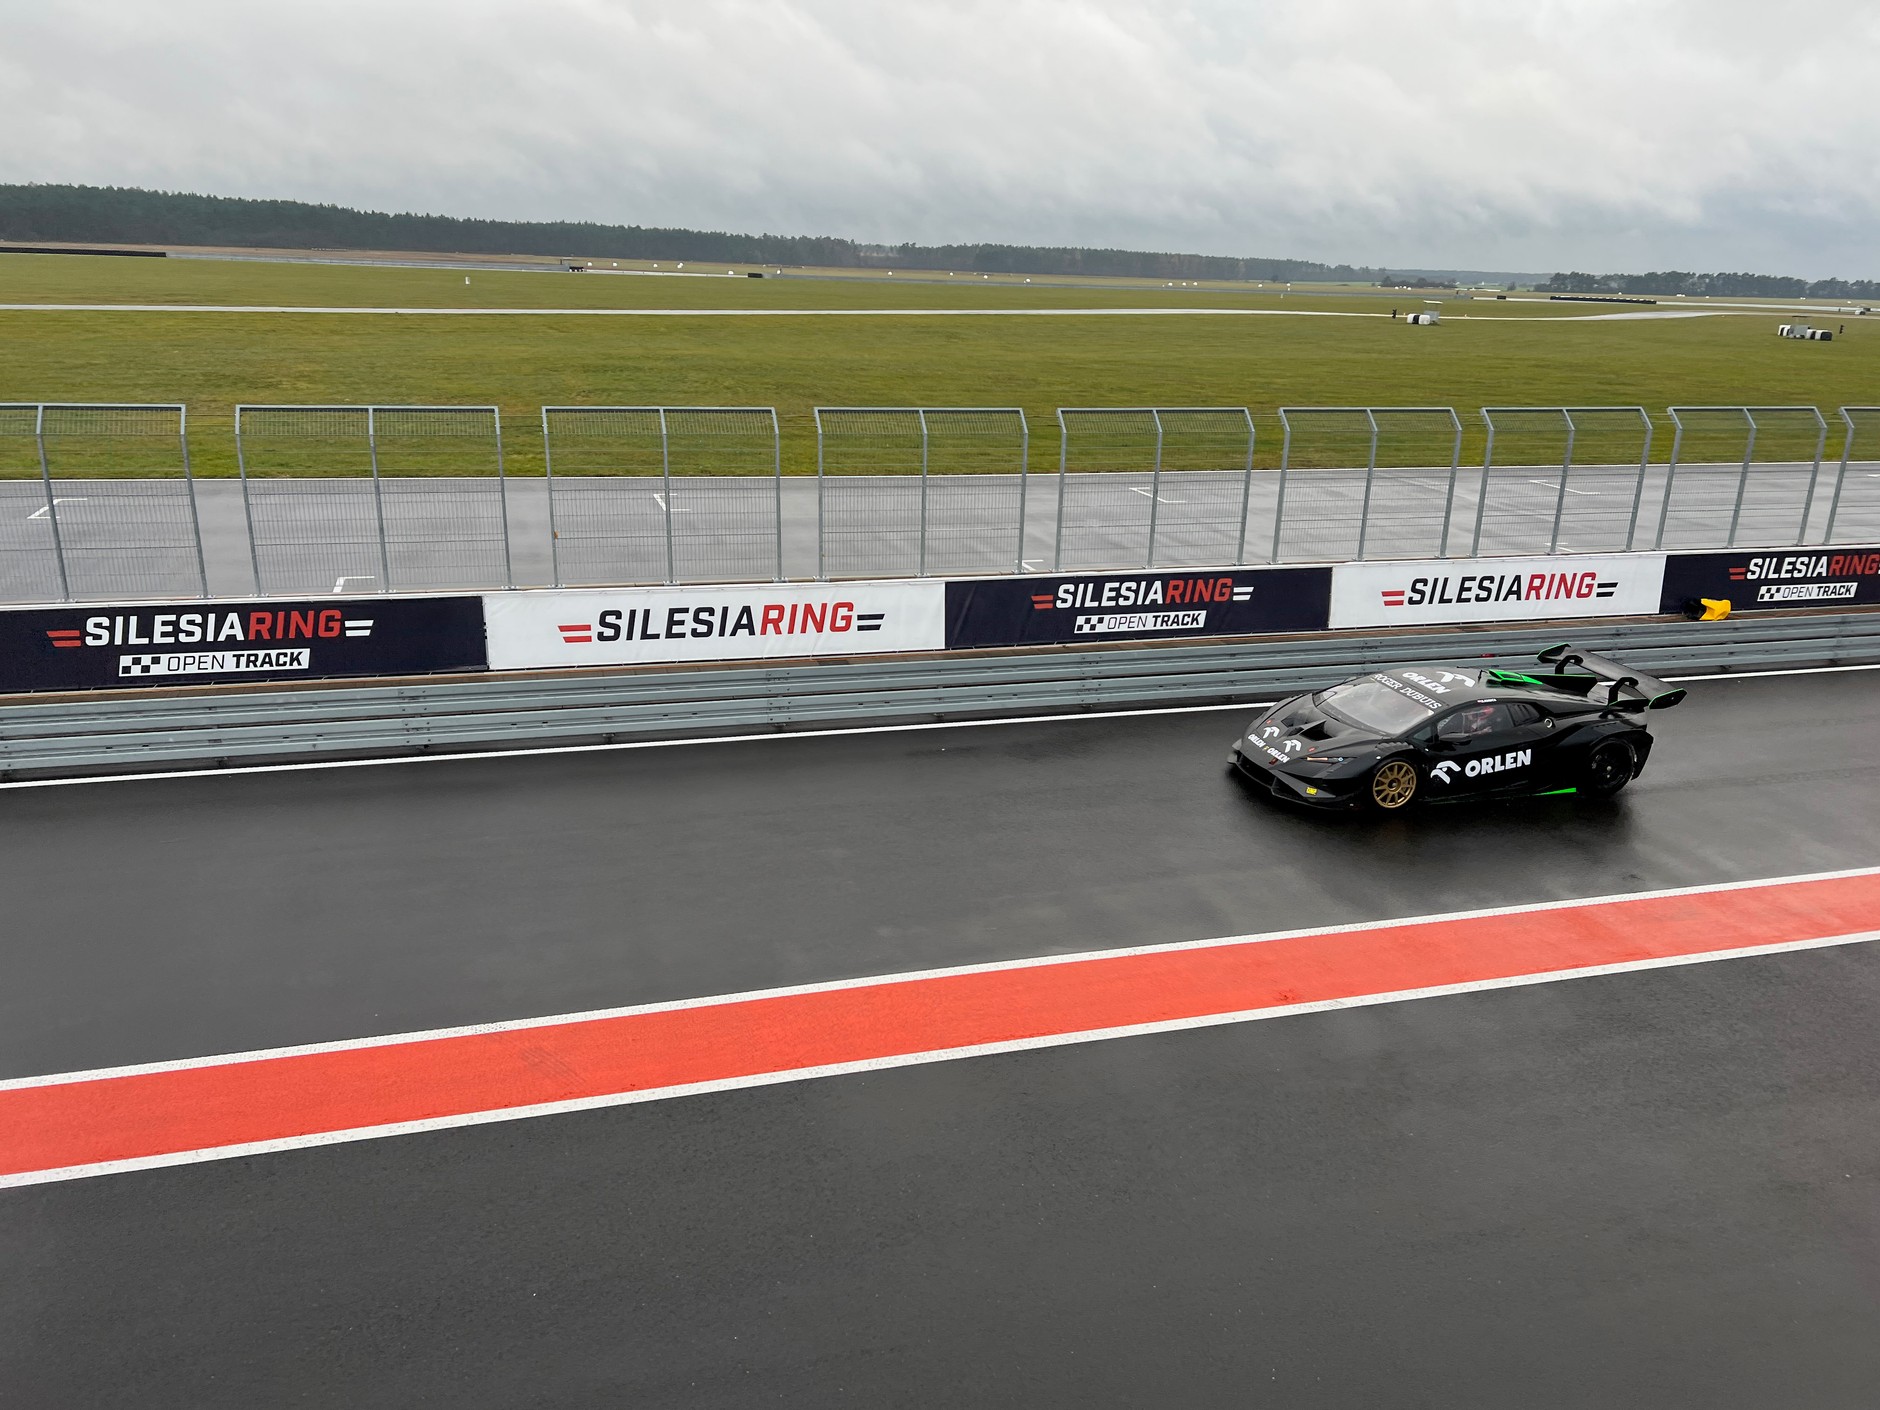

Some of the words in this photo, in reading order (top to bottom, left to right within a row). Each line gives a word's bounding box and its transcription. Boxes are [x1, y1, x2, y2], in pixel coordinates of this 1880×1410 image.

[1747, 553, 1880, 580] SILESIARING
[1055, 577, 1234, 609] SILESIARING
[1407, 571, 1598, 606] SILESIARING
[1782, 586, 1814, 598] OPEN
[1816, 584, 1854, 597] TRACK
[84, 609, 343, 647] SILESIARING
[597, 601, 855, 642] SILESIARING
[1107, 615, 1148, 631] OPEN
[1152, 612, 1202, 628] TRACK
[167, 653, 226, 672] OPEN
[232, 650, 304, 669] TRACK
[1374, 673, 1403, 690] ROGER
[1400, 687, 1442, 709] DUBUIS
[1402, 672, 1452, 694] ORLEN
[1267, 747, 1291, 764] ORLEN
[1464, 748, 1532, 778] ORLEN
